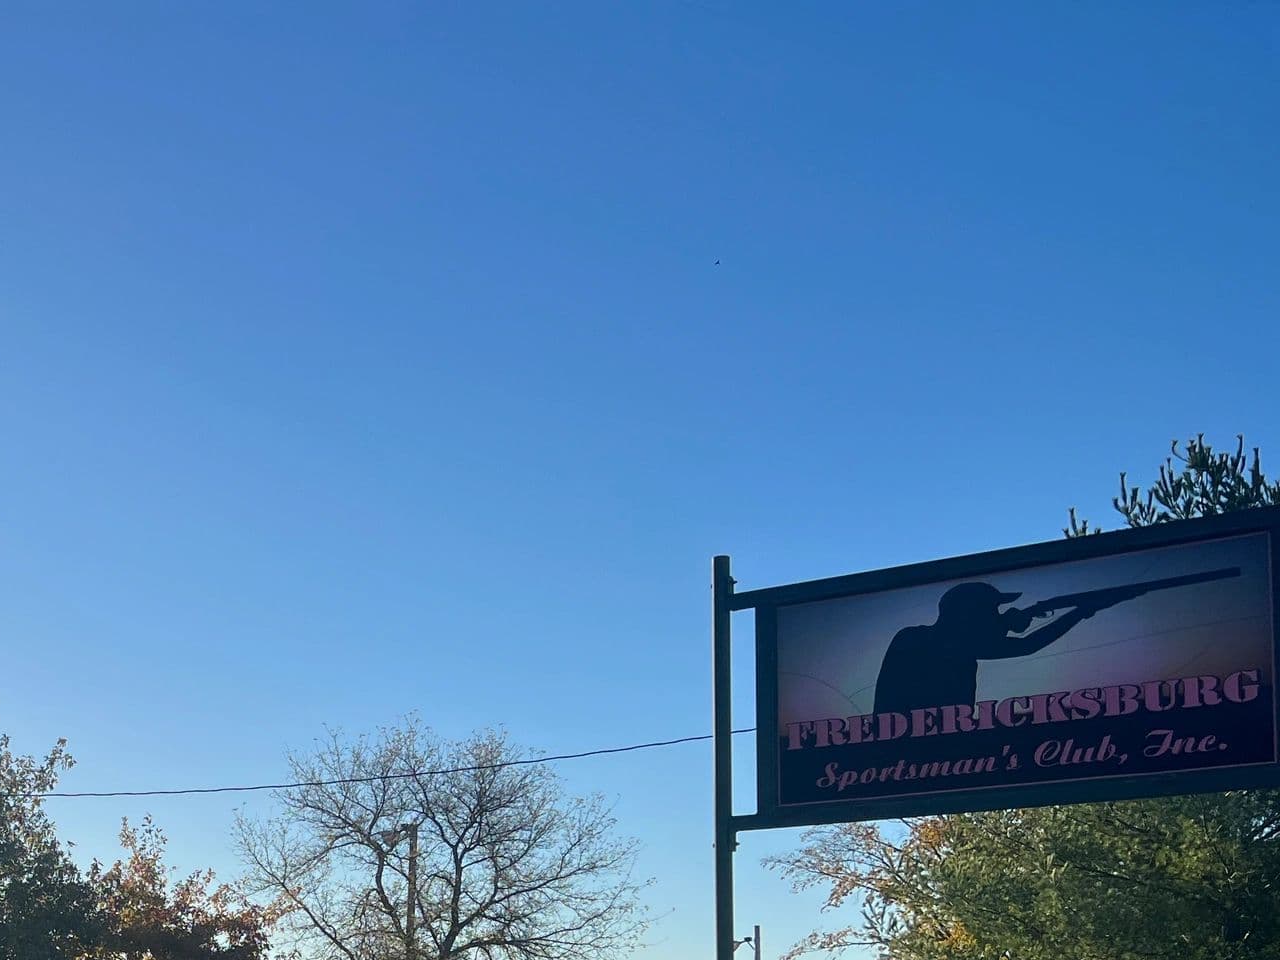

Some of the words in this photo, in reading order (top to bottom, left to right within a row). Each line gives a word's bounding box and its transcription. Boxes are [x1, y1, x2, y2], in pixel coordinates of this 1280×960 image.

[786, 669, 1262, 751] FREDERICKSBURG
[816, 745, 1021, 792] Sportsman's
[1033, 735, 1128, 769] Club,
[1143, 728, 1228, 758] Inc.
